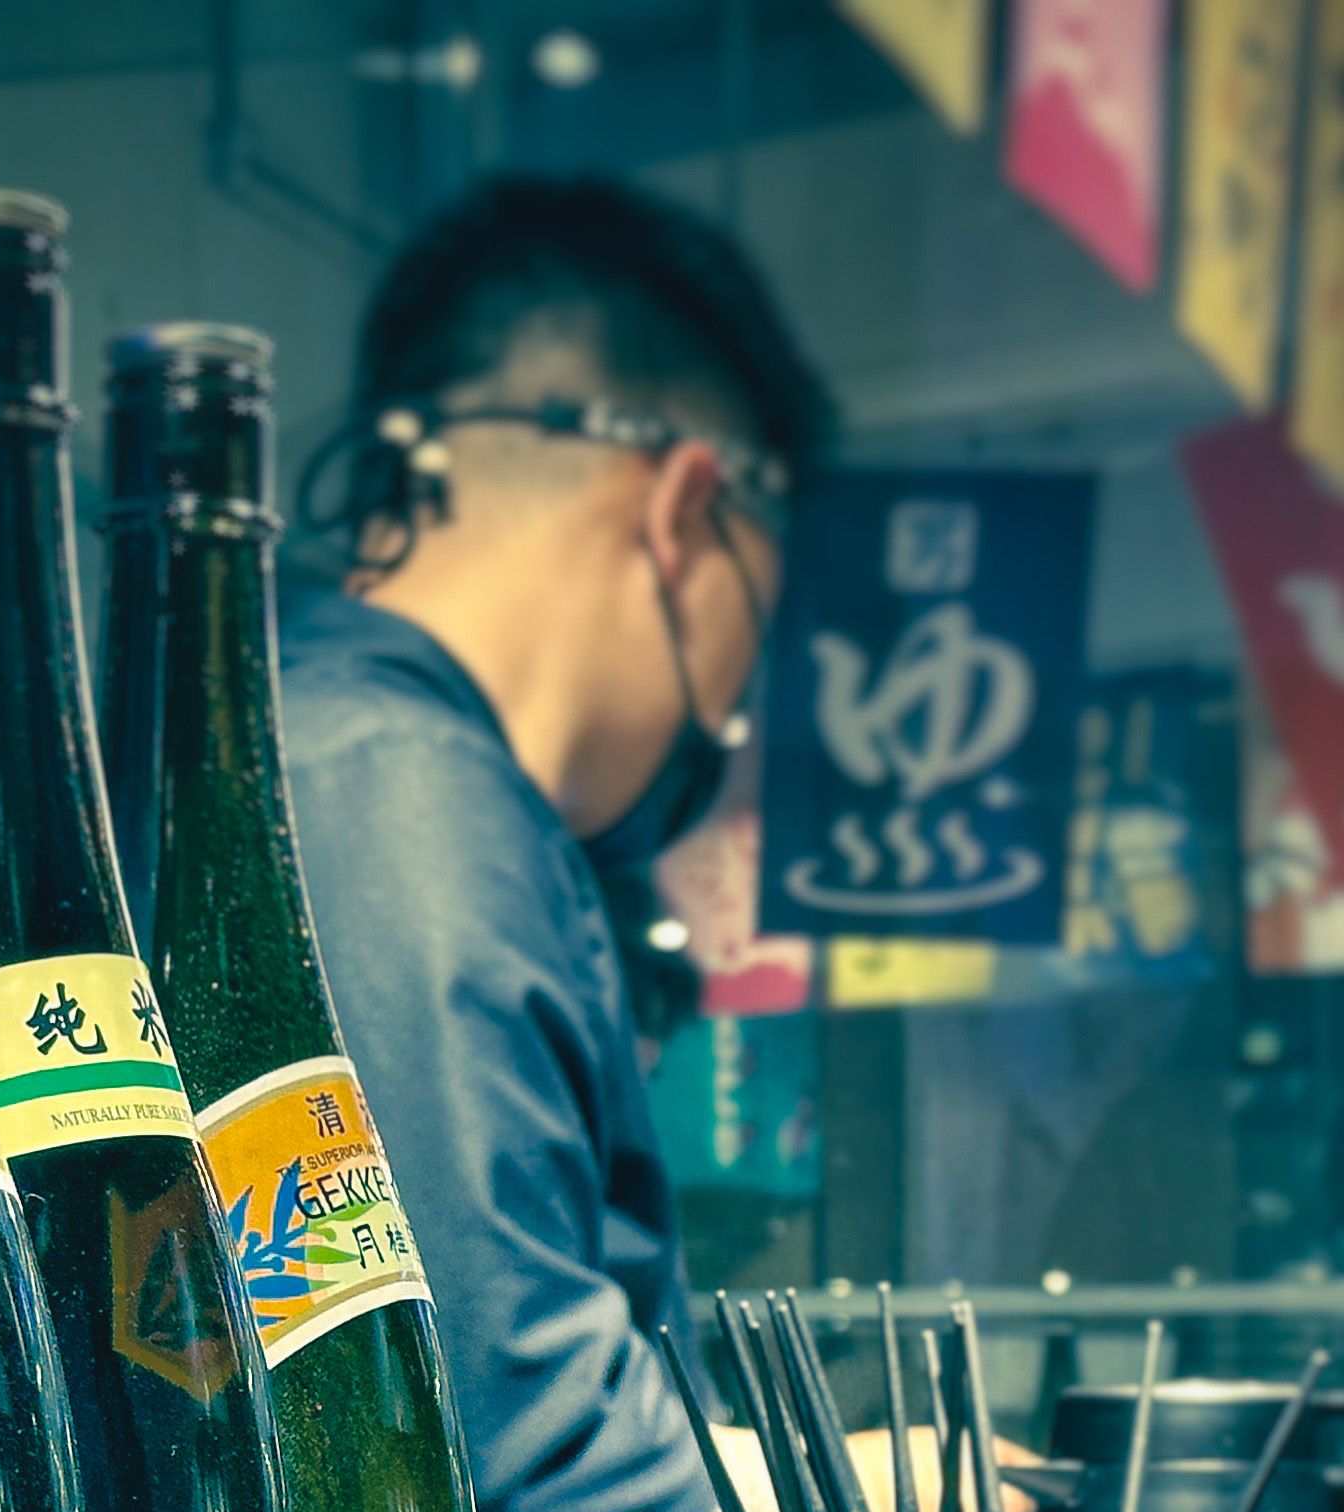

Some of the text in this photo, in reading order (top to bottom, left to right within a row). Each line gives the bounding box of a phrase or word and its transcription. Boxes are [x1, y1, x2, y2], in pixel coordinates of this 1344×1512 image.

[25, 978, 169, 1058] 纯米
[50, 1104, 131, 1129] NATURALLY
[133, 1104, 161, 1120] PURE
[306, 1143, 365, 1170] SUPERIOR
[294, 1166, 391, 1220] GEKKE
[352, 1222, 410, 1269] 月桂
